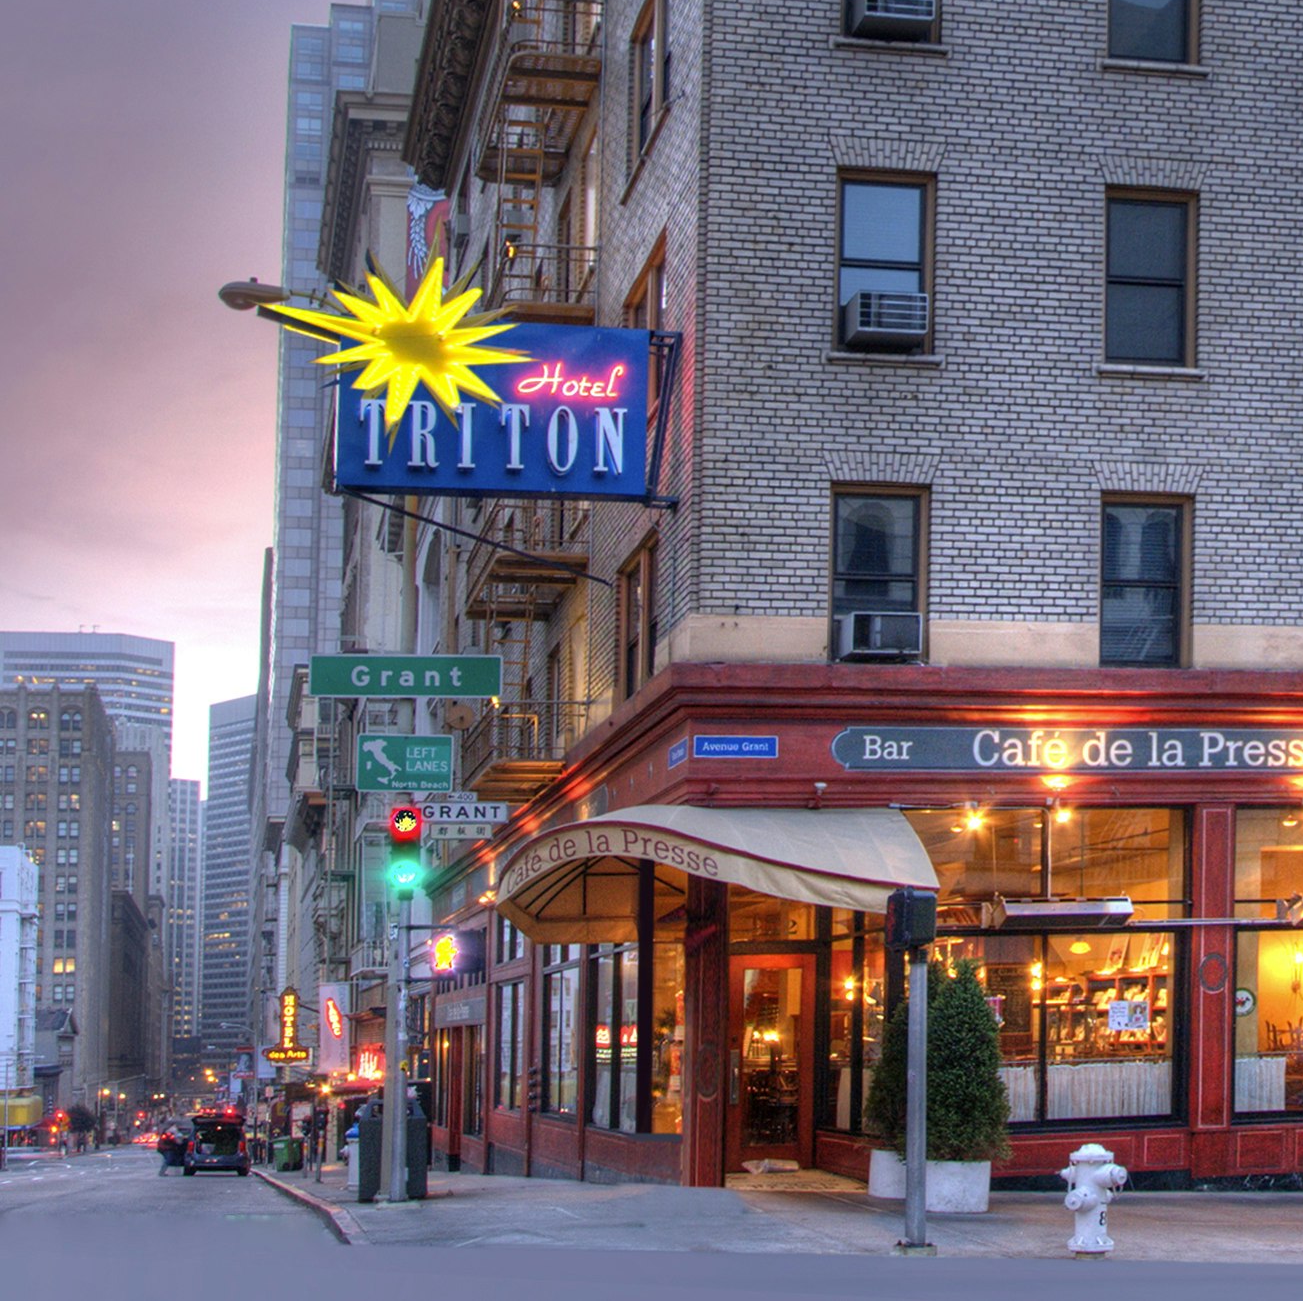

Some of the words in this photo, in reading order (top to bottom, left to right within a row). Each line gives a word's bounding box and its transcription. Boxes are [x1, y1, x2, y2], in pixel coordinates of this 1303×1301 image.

[517, 363, 625, 398] Hotel
[359, 398, 629, 476] TRITON
[350, 665, 463, 688] Grant
[406, 747, 437, 759] LEFT
[702, 742, 739, 752] Avenue
[741, 742, 769, 752] Grant
[862, 735, 913, 760] Bar
[972, 730, 1069, 767] Café
[1081, 731, 1133, 767] de
[1148, 732, 1186, 767] la
[406, 760, 449, 772] LANES
[391, 780, 417, 789] North
[420, 780, 449, 789] Beach
[422, 805, 501, 818] GRANT
[506, 848, 542, 893] Café
[549, 837, 576, 861] de
[585, 830, 610, 854] la
[620, 828, 718, 877] Presse
[284, 994, 295, 1048] HOTEL
